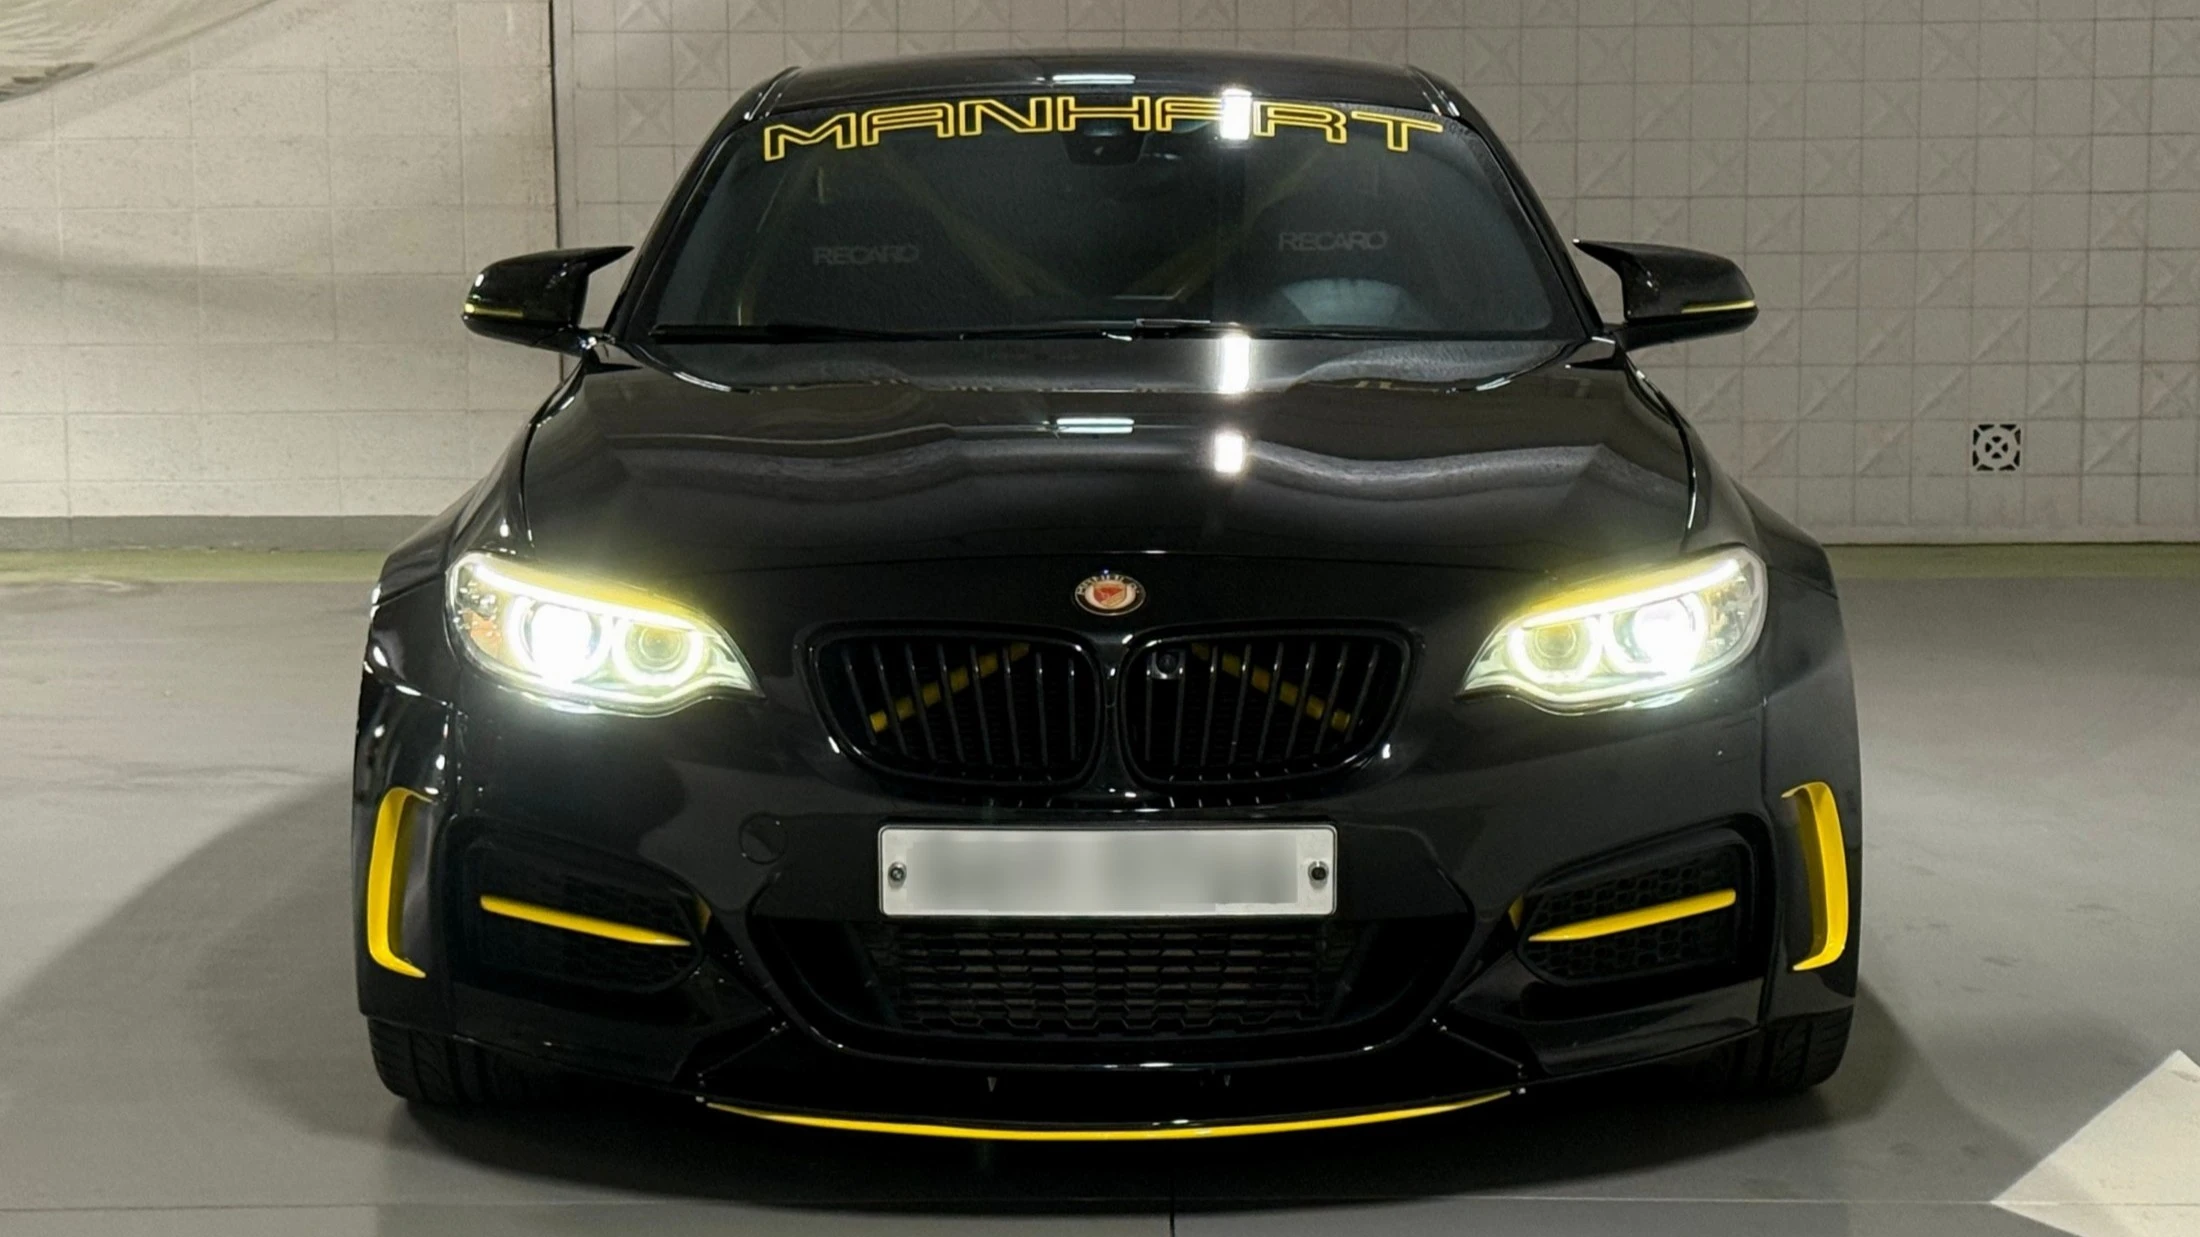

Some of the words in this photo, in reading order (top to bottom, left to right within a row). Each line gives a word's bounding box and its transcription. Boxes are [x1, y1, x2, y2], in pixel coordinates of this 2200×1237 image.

[763, 95, 1444, 162] MANHART
[1278, 230, 1388, 252] RECARO
[812, 243, 921, 266] RECARO
